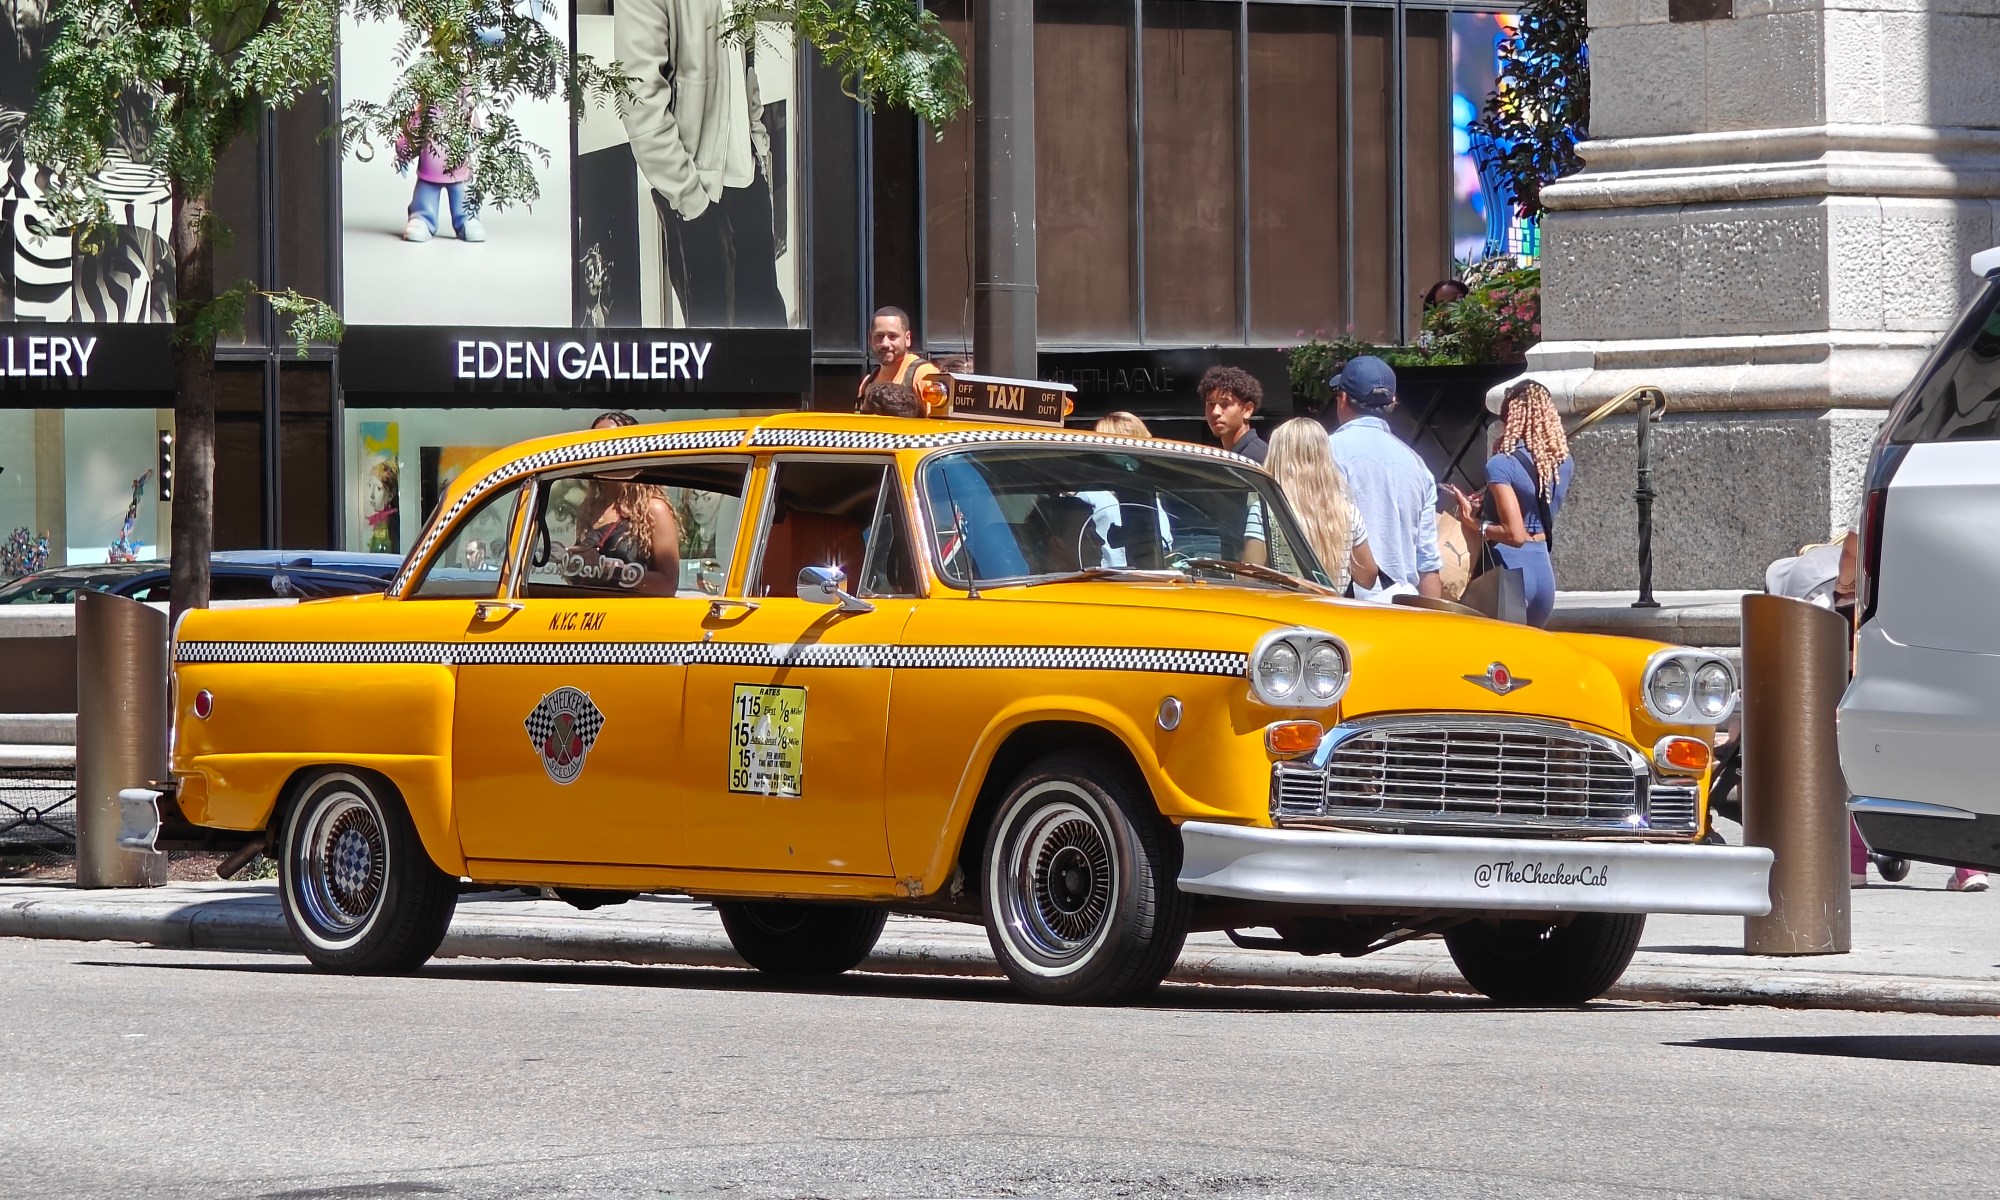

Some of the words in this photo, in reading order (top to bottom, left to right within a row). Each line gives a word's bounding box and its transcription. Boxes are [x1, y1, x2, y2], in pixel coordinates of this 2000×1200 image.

[458, 341, 549, 379] EDEN
[557, 341, 712, 380] GALLERY
[1114, 366, 1174, 392] AVENUE
[958, 384, 974, 394] OFF
[986, 384, 1025, 412] TAXI
[1041, 393, 1056, 403] OFF
[955, 396, 975, 407] DUTY
[1038, 405, 1058, 416] DUTY
[548, 612, 577, 631] N.Y.C.
[580, 612, 607, 631] TAXI
[759, 688, 780, 696] RATES
[547, 690, 583, 714] CHECKER
[549, 760, 580, 777] SPECIAL
[1474, 860, 1609, 888] @TheCheckerCab
